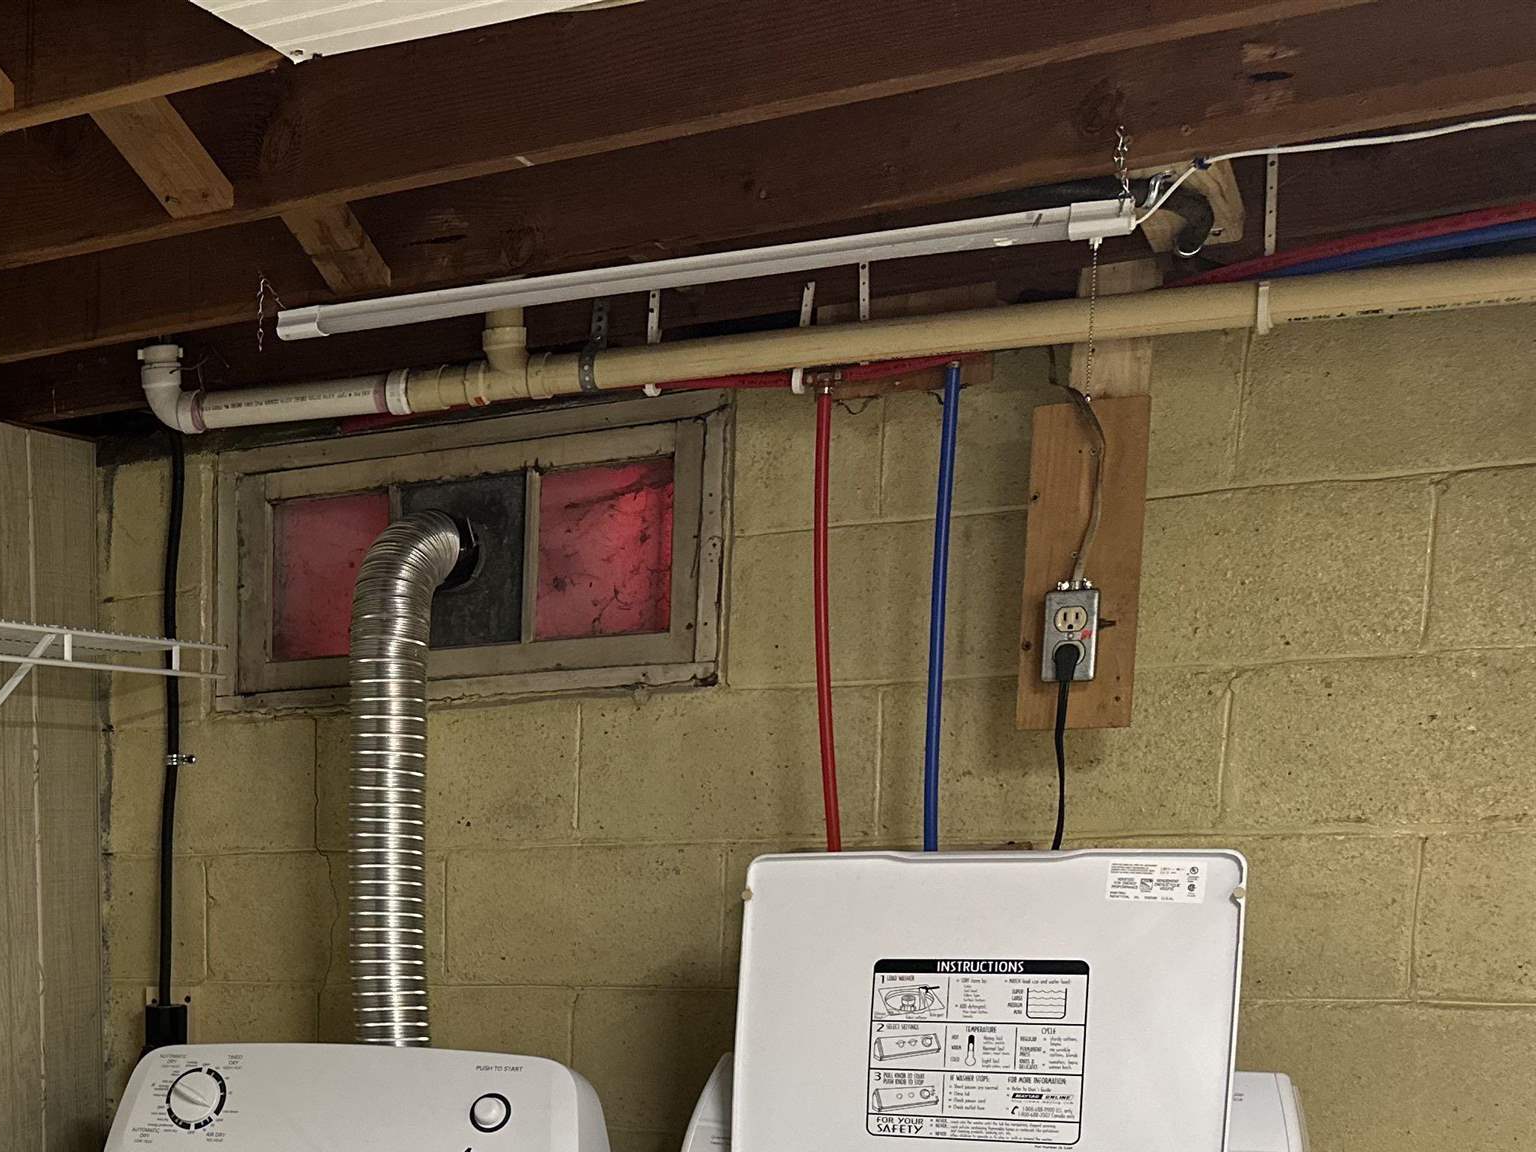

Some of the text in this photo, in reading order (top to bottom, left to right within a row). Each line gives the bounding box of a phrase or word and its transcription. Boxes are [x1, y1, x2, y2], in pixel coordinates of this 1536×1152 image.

[937, 960, 1024, 973] INSTRUCTIONS
[881, 975, 885, 985] 1
[876, 1023, 884, 1032] 2
[873, 1072, 882, 1081] 3
[876, 1124, 923, 1134] SAFETY
